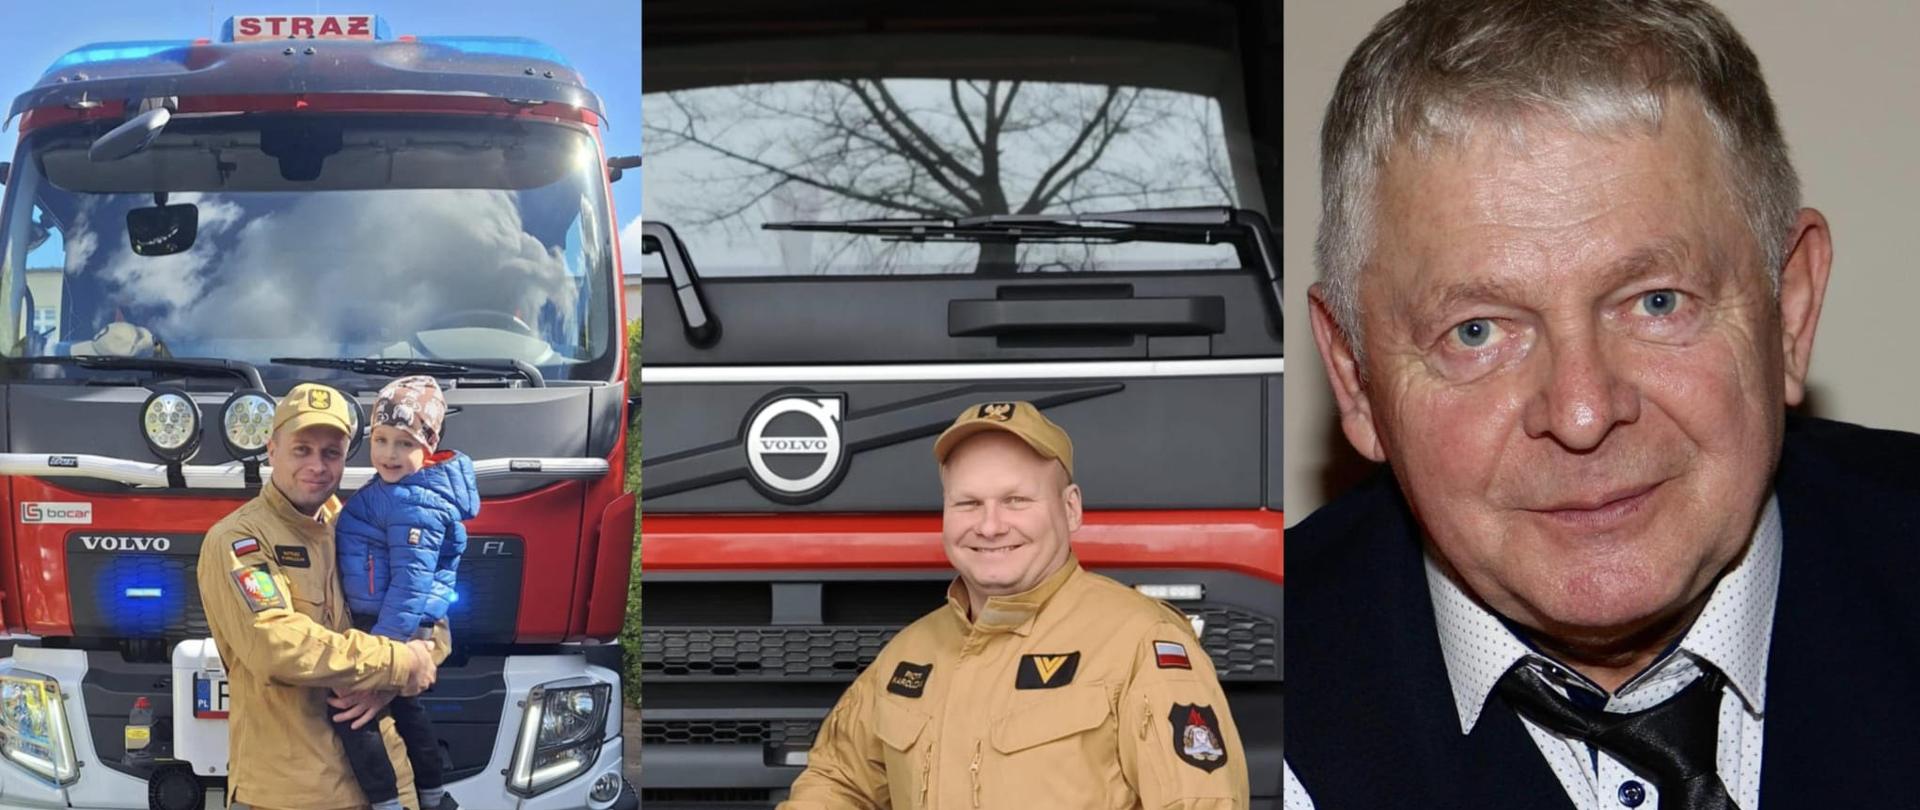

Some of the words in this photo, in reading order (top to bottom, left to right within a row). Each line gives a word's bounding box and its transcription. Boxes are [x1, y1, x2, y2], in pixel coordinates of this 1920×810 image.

[761, 439, 828, 450] VOLVO
[46, 507, 91, 519] bocar
[79, 536, 171, 551] VOLVO
[482, 541, 512, 555] FL
[198, 699, 209, 708] PL
